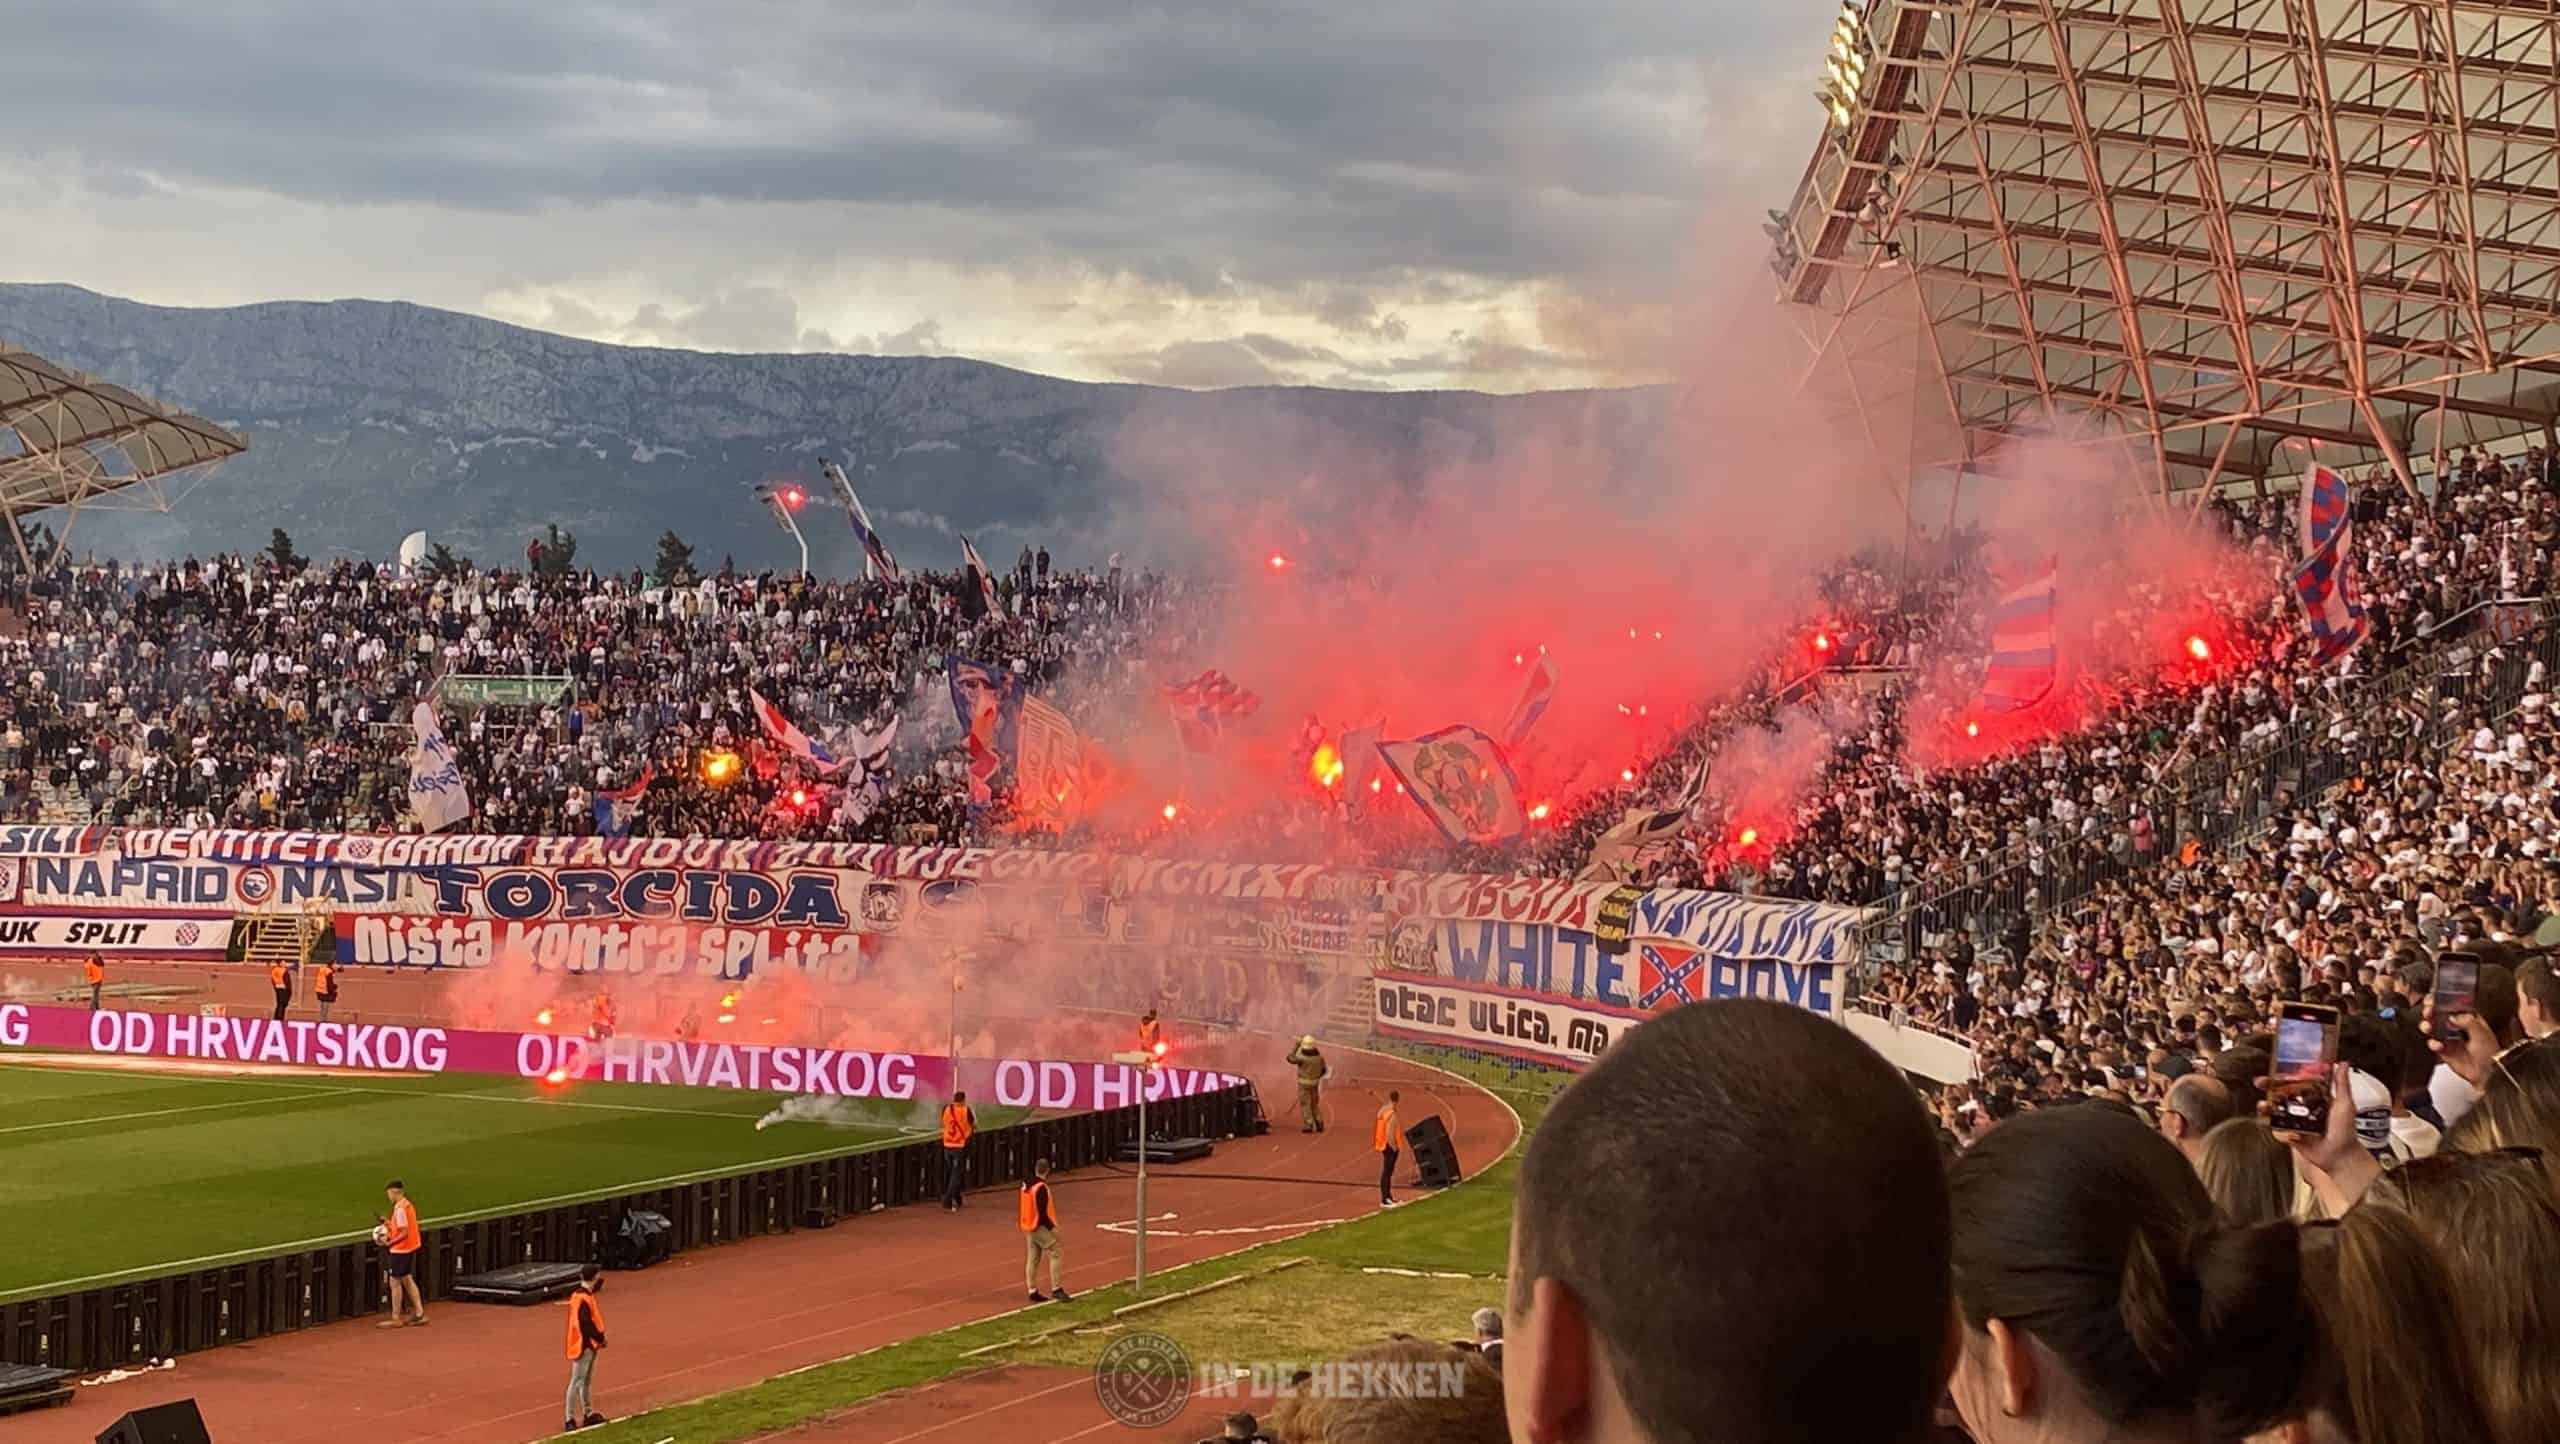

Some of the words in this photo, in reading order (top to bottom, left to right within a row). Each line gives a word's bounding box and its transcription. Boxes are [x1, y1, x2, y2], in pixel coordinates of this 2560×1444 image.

[121, 829, 344, 862] IDENTITET
[383, 835, 524, 867] GRADA
[530, 836, 760, 870] HAJDUK
[37, 857, 228, 903] NAPRID
[420, 866, 849, 929] TORCIDA
[64, 923, 147, 944] SPLIT
[504, 921, 687, 975] kontra
[1448, 919, 1630, 1008] WHITE
[90, 1010, 154, 1054] OD
[167, 1014, 448, 1072] HRVATSKOG
[517, 1033, 589, 1078] OD
[603, 1036, 917, 1100] HRVATSKOG
[995, 1059, 1077, 1110] OD
